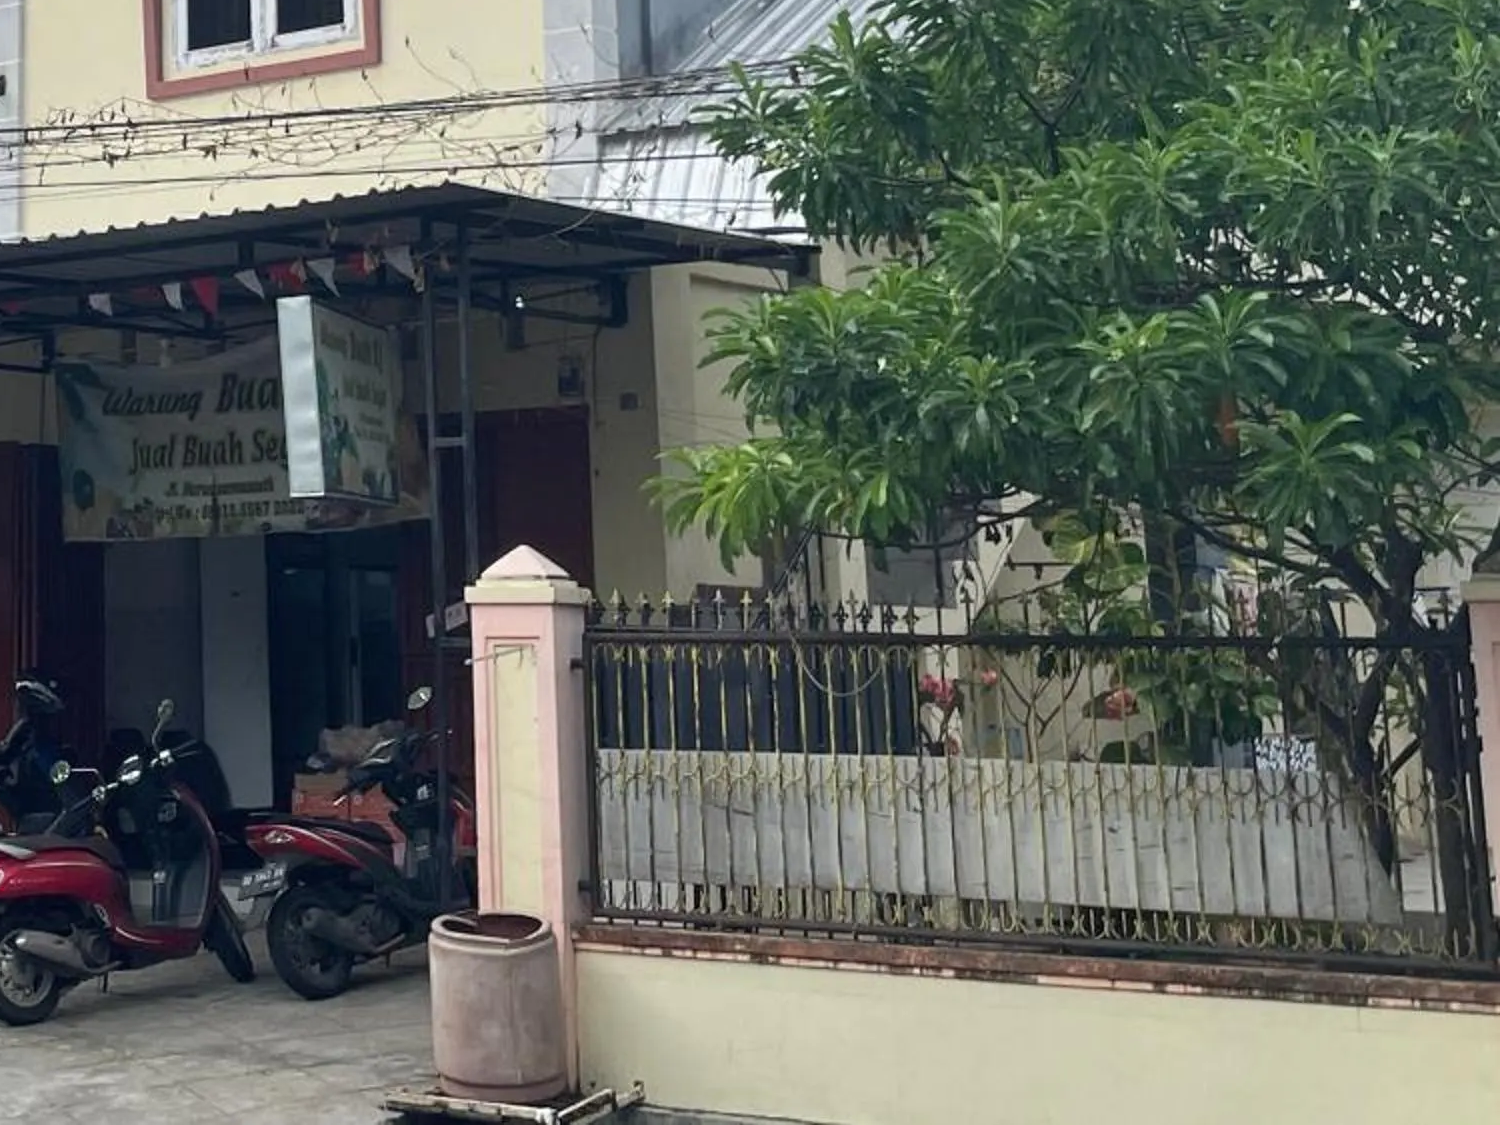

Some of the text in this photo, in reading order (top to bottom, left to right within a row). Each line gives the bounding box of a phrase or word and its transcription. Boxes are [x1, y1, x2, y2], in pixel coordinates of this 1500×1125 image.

[102, 386, 203, 421] Warung
[130, 434, 174, 475] Jual
[183, 428, 244, 467] Buah
